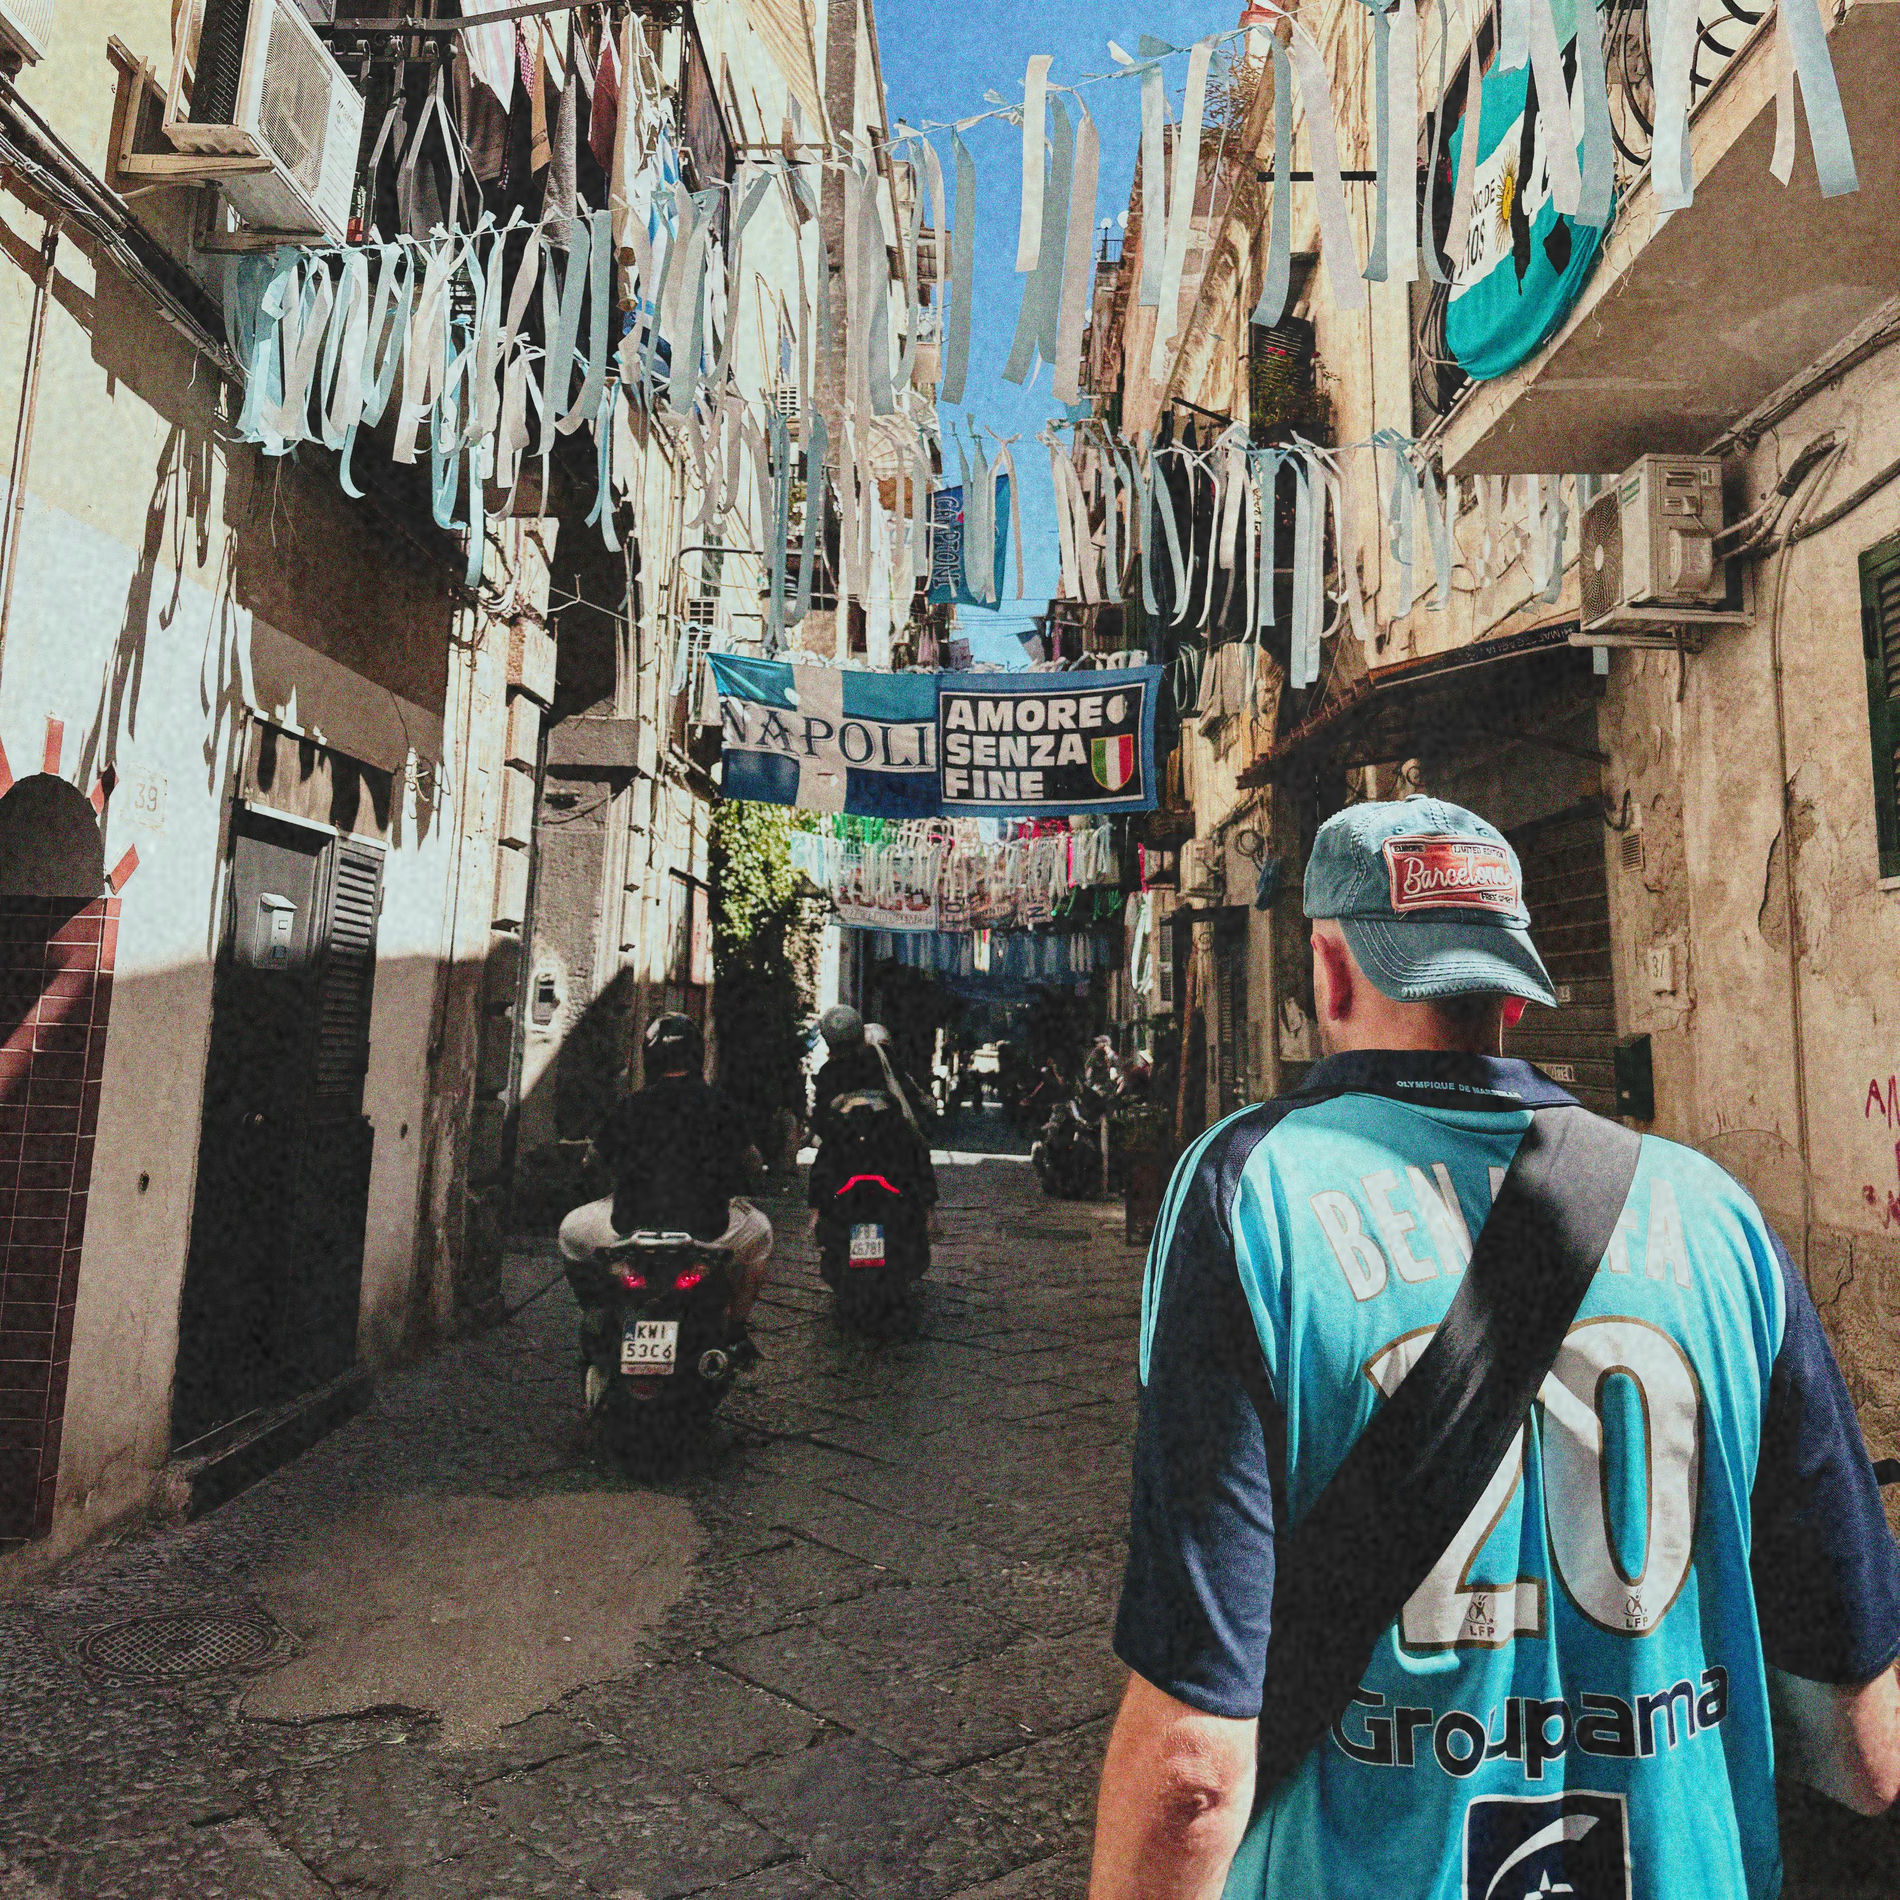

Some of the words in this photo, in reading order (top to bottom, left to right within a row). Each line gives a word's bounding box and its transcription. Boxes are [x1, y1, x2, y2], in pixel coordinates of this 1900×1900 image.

[1485, 178, 1495, 208] DE
[1458, 218, 1485, 280] IOS
[946, 695, 1103, 731] AMORE
[721, 700, 934, 767] NAPOLI
[946, 733, 1087, 767] SENZA
[135, 783, 157, 811] 39
[945, 767, 1044, 799] FINE
[1453, 845, 1481, 854] LIMITED
[1404, 855, 1513, 894] Barcelona
[1481, 892, 1497, 902] FREE
[1396, 1080, 1456, 1090] OLYMPIQUE
[1459, 1084, 1471, 1092] DE
[1309, 1162, 1474, 1302] BEN
[626, 1343, 672, 1359] 53C6
[1469, 1625, 1495, 1638] LFP
[1625, 1617, 1649, 1629] LFP
[1331, 1664, 1730, 1781] Groupama
